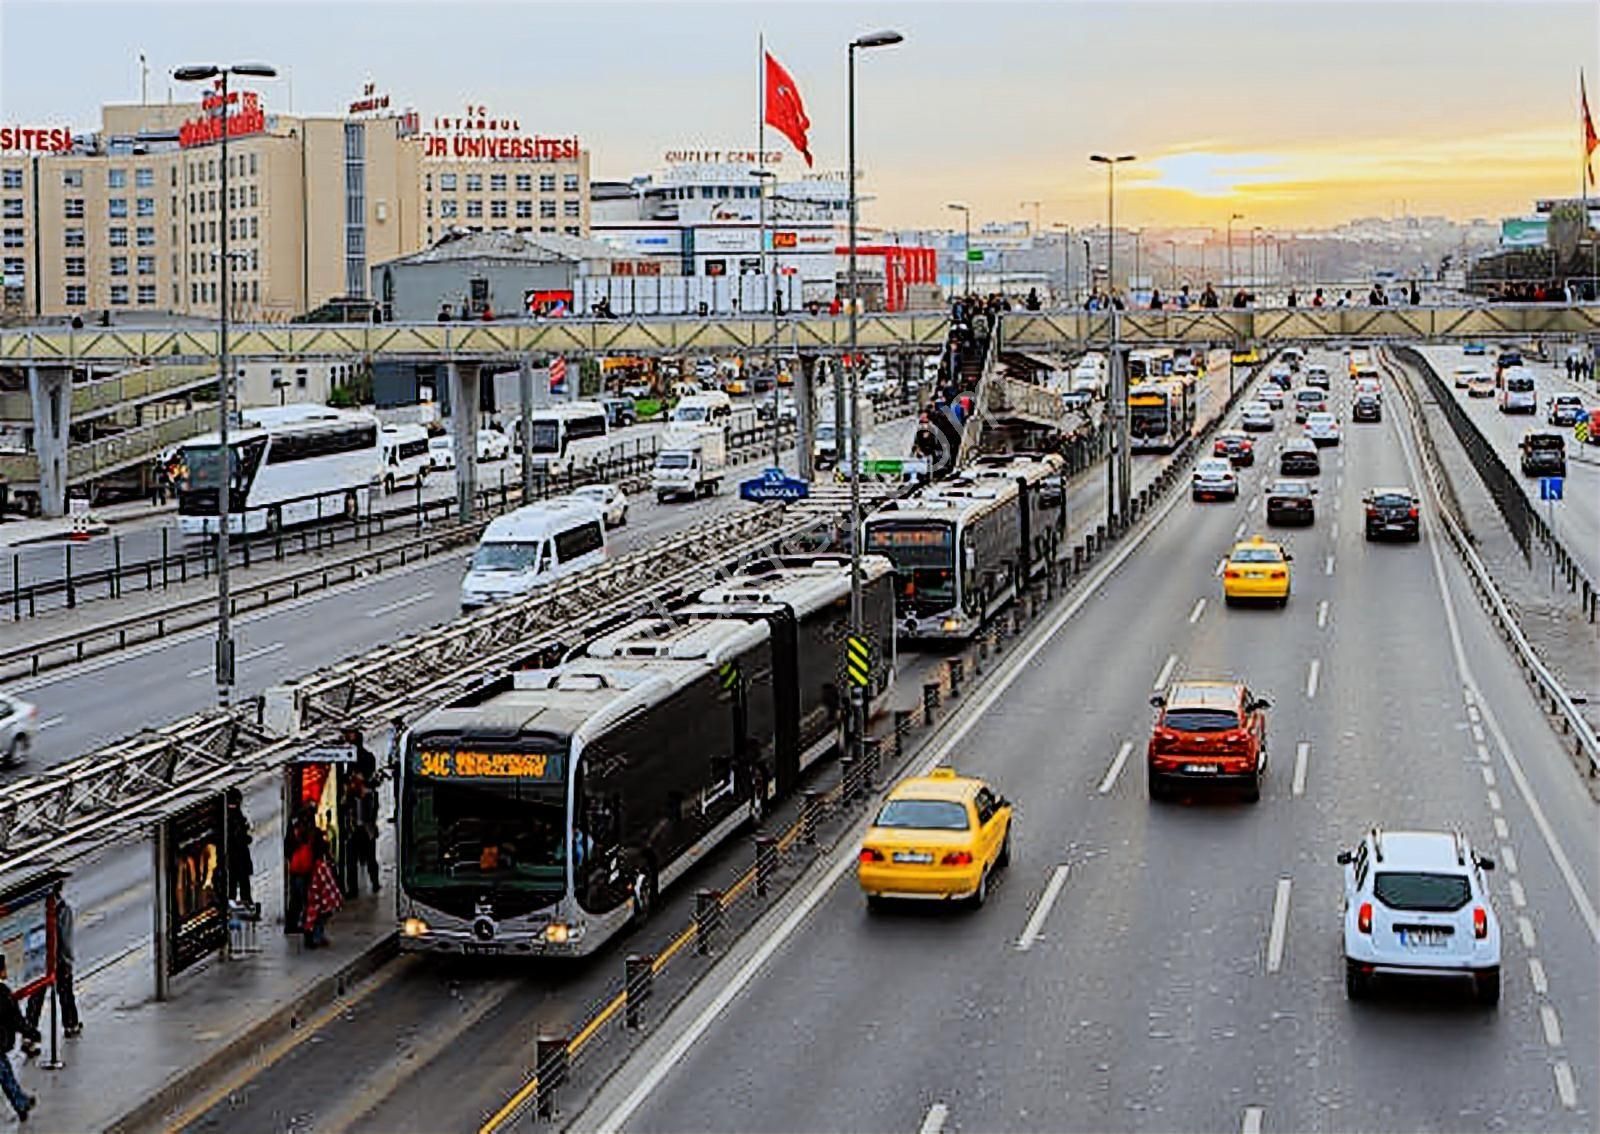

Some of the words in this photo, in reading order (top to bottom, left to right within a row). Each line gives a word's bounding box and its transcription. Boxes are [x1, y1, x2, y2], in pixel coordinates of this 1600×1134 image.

[453, 134, 579, 158] ÜNİVERSİTESİ
[665, 151, 720, 163] OUTLET
[420, 752, 450, 776] 34C
